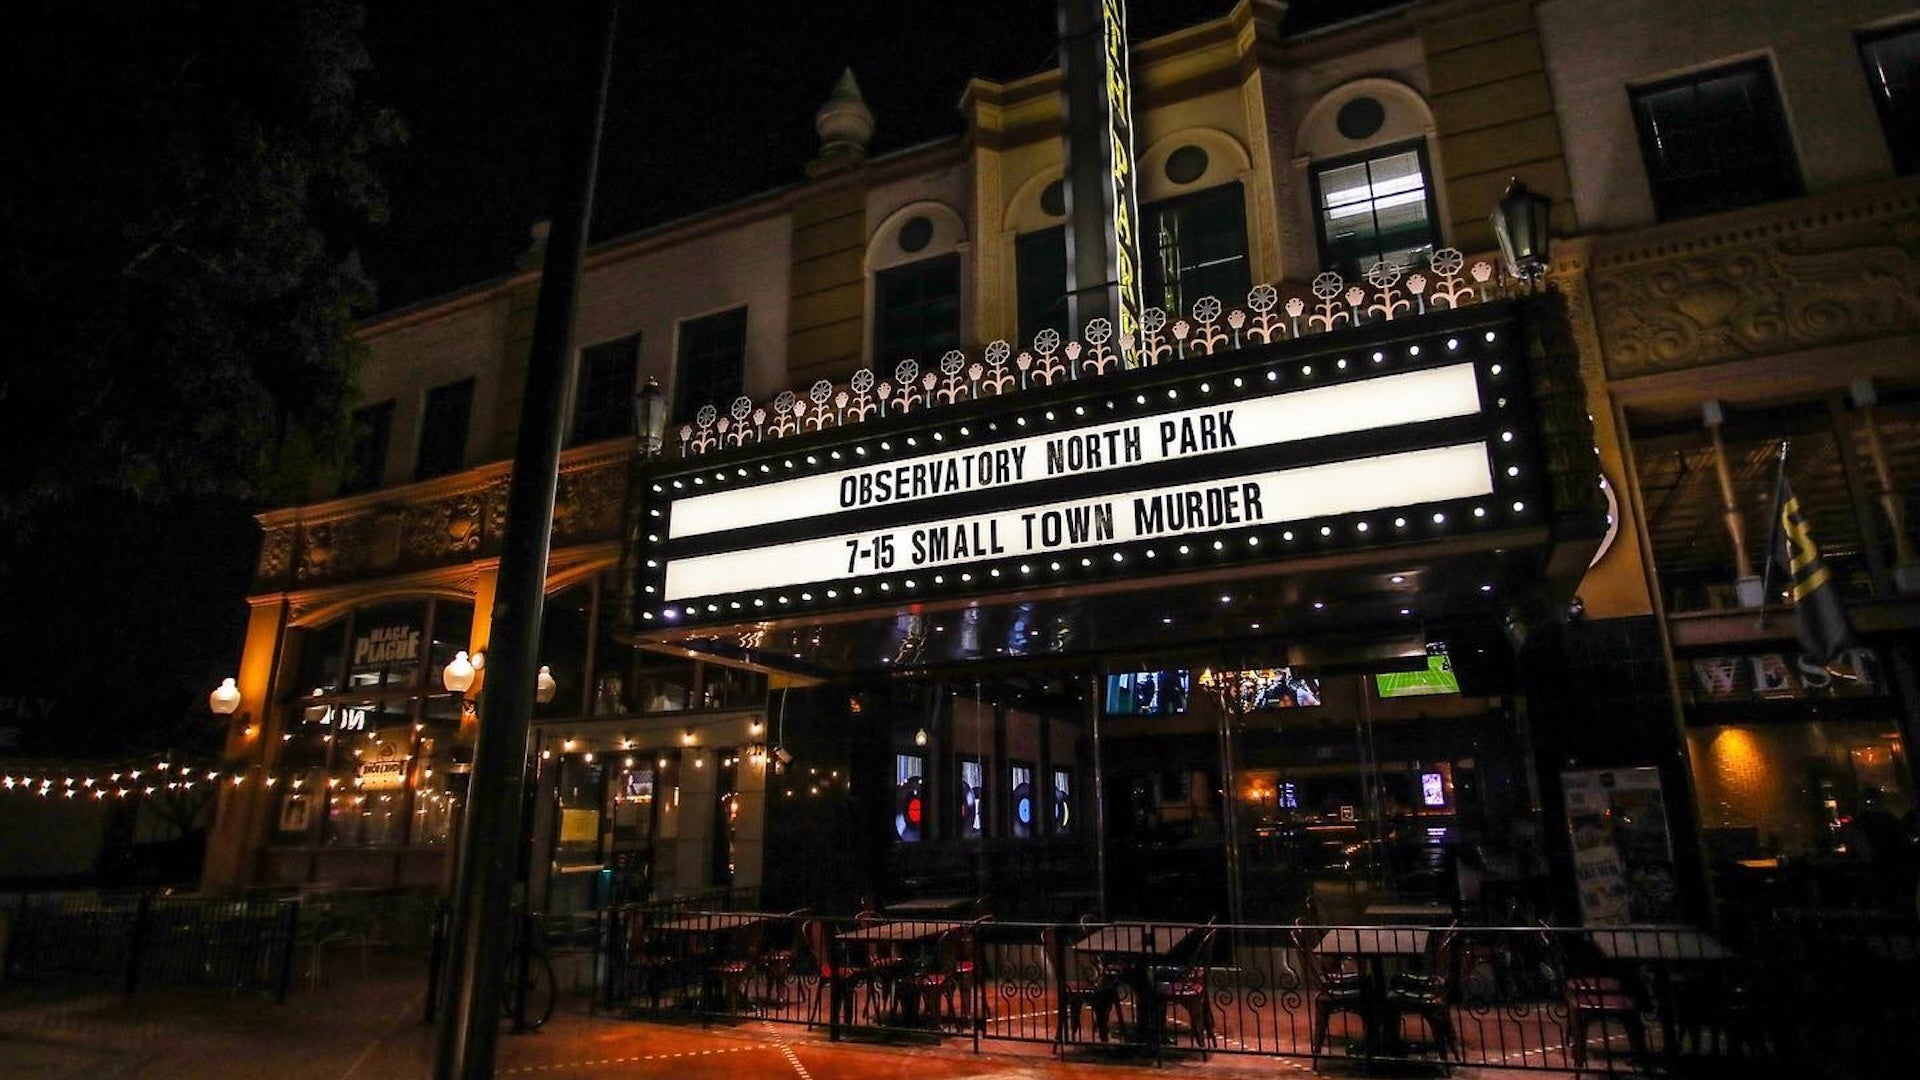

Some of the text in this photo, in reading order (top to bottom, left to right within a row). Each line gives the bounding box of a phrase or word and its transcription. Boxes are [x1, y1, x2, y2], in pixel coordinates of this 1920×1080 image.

[839, 410, 1238, 508] OBSERVATORY NORTH PARK
[846, 482, 1264, 574] 7-15 SMALL TOWN MURDER
[354, 631, 421, 665] PLAGUE
[369, 626, 410, 642] BLACK
